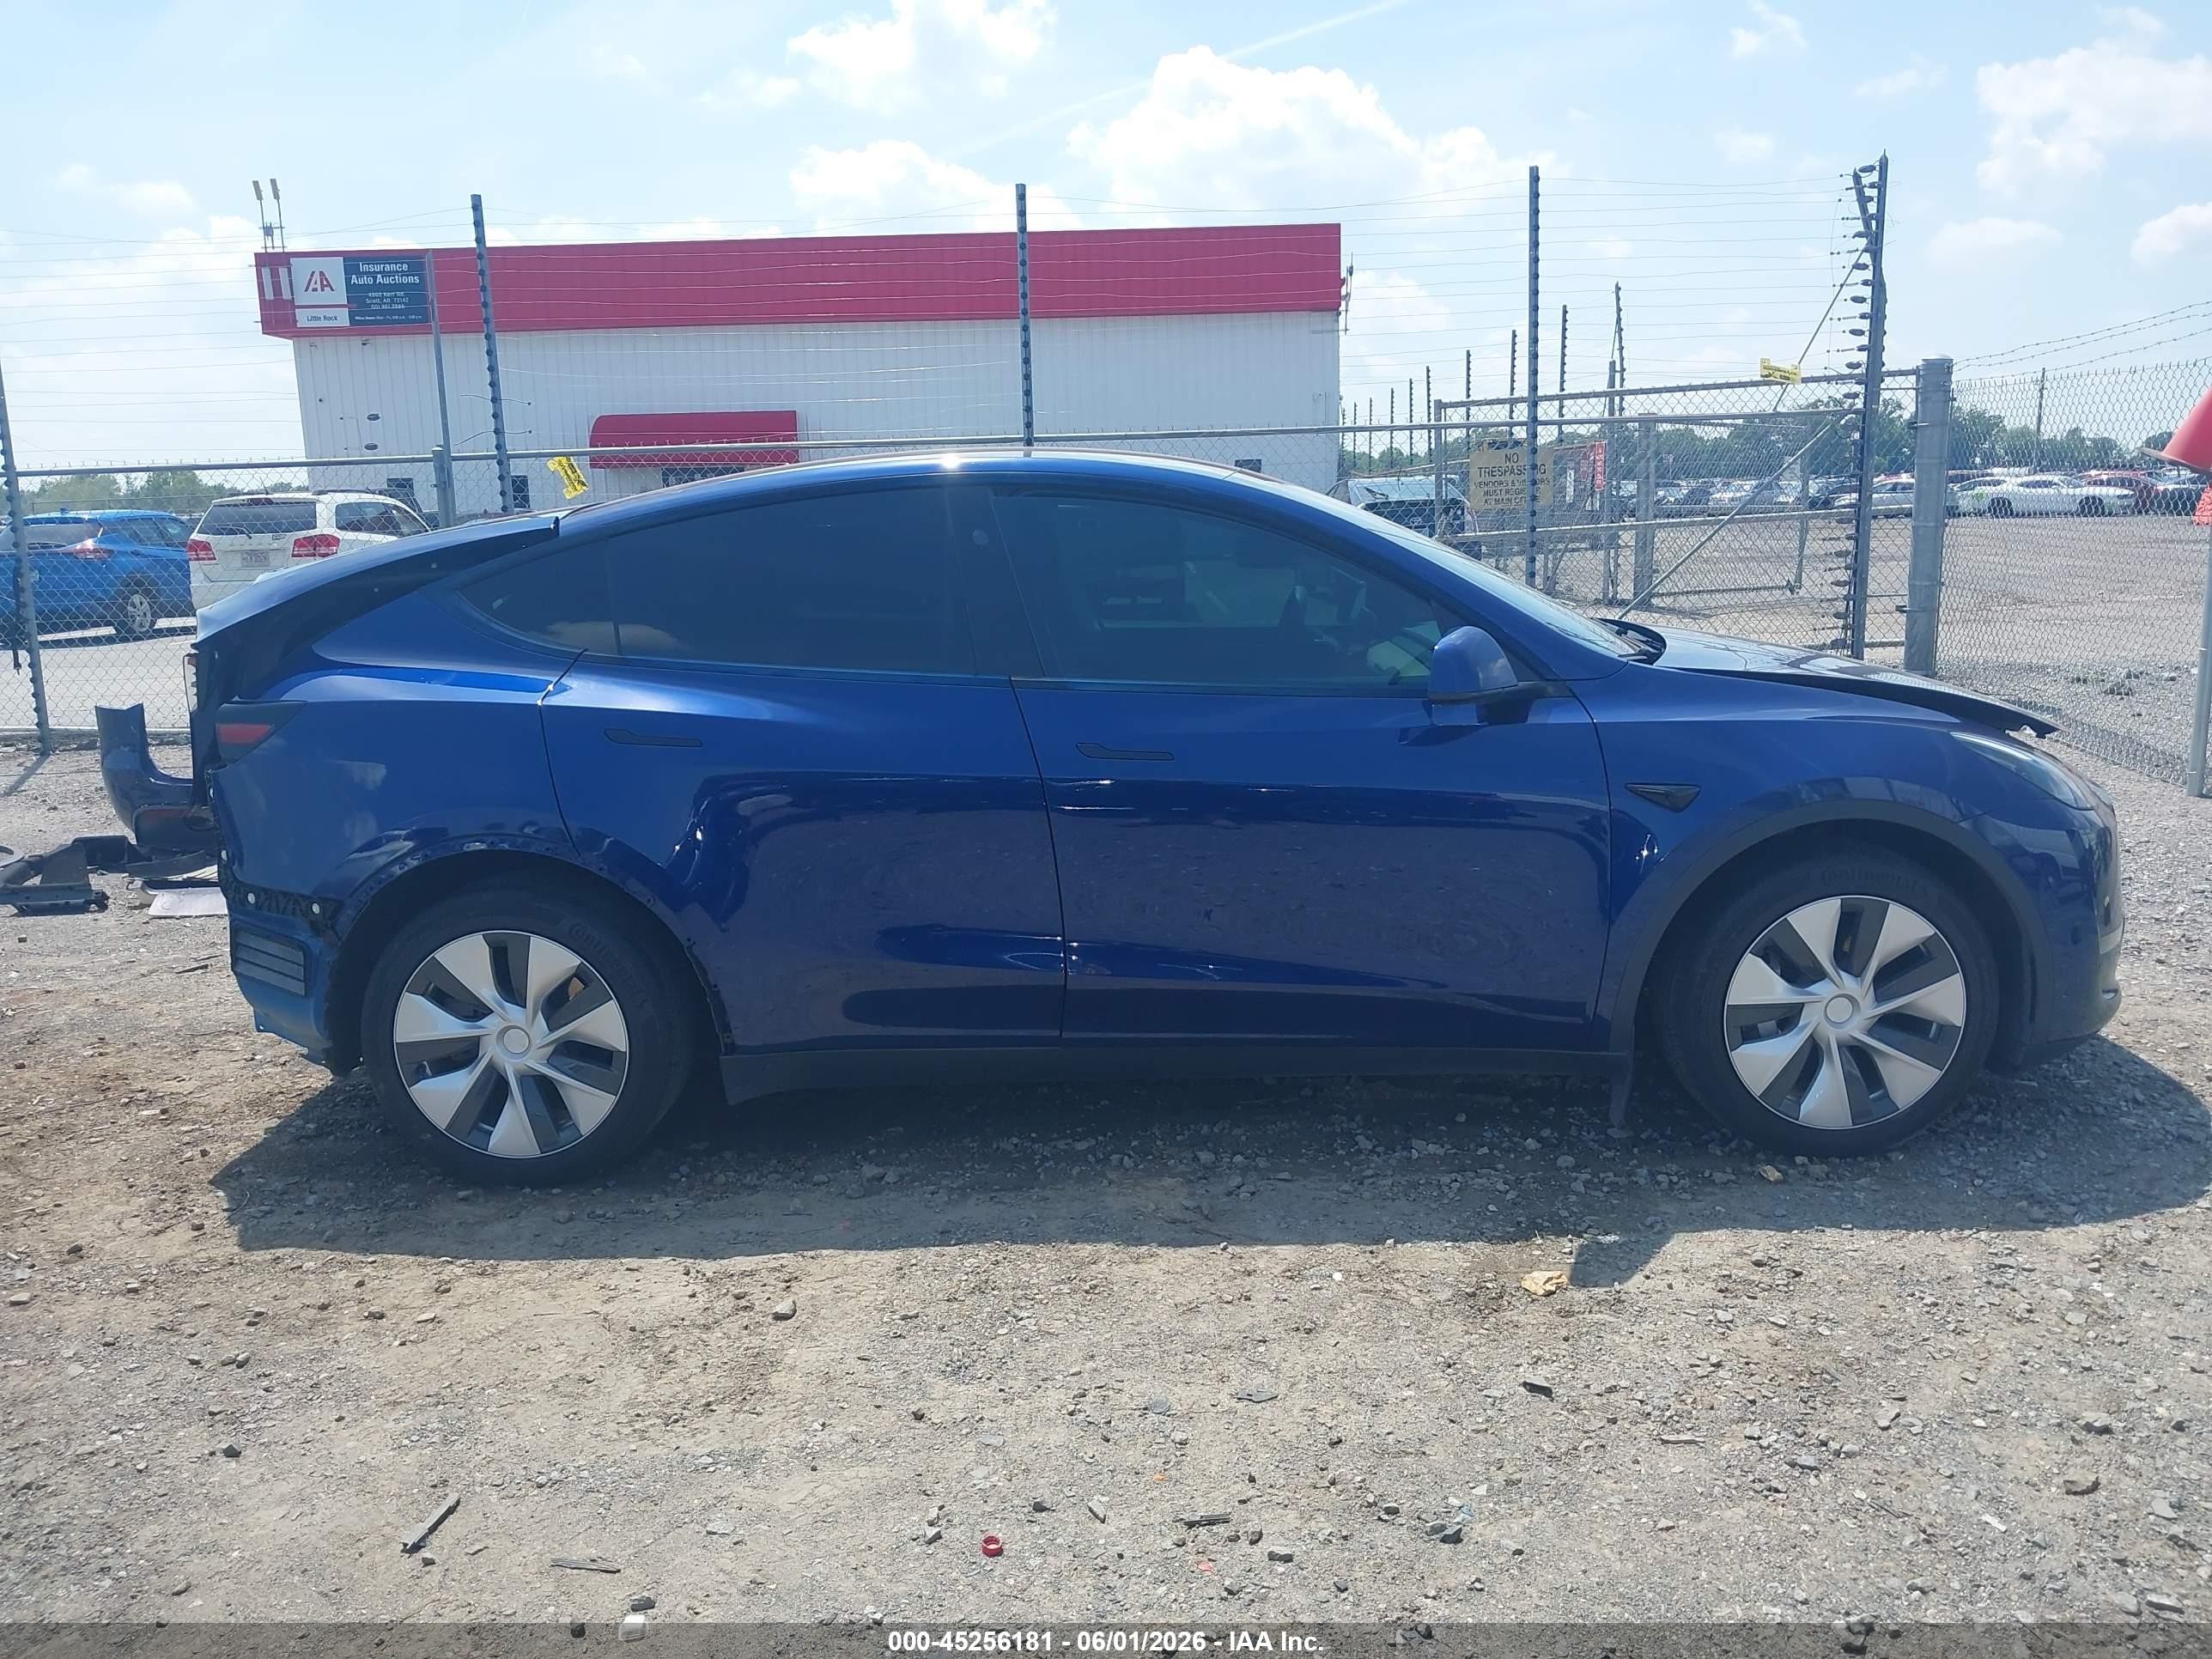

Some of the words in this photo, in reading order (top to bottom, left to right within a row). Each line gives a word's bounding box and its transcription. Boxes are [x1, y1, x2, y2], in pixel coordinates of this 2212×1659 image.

[359, 262, 409, 272] Insurance
[350, 274, 374, 285] Auto
[375, 272, 420, 284] Auctions
[1504, 452, 1519, 464] NO
[1474, 479, 1510, 489] VENDORS
[1483, 489, 1504, 497] MUST
[1494, 496, 1513, 506] MAIN
